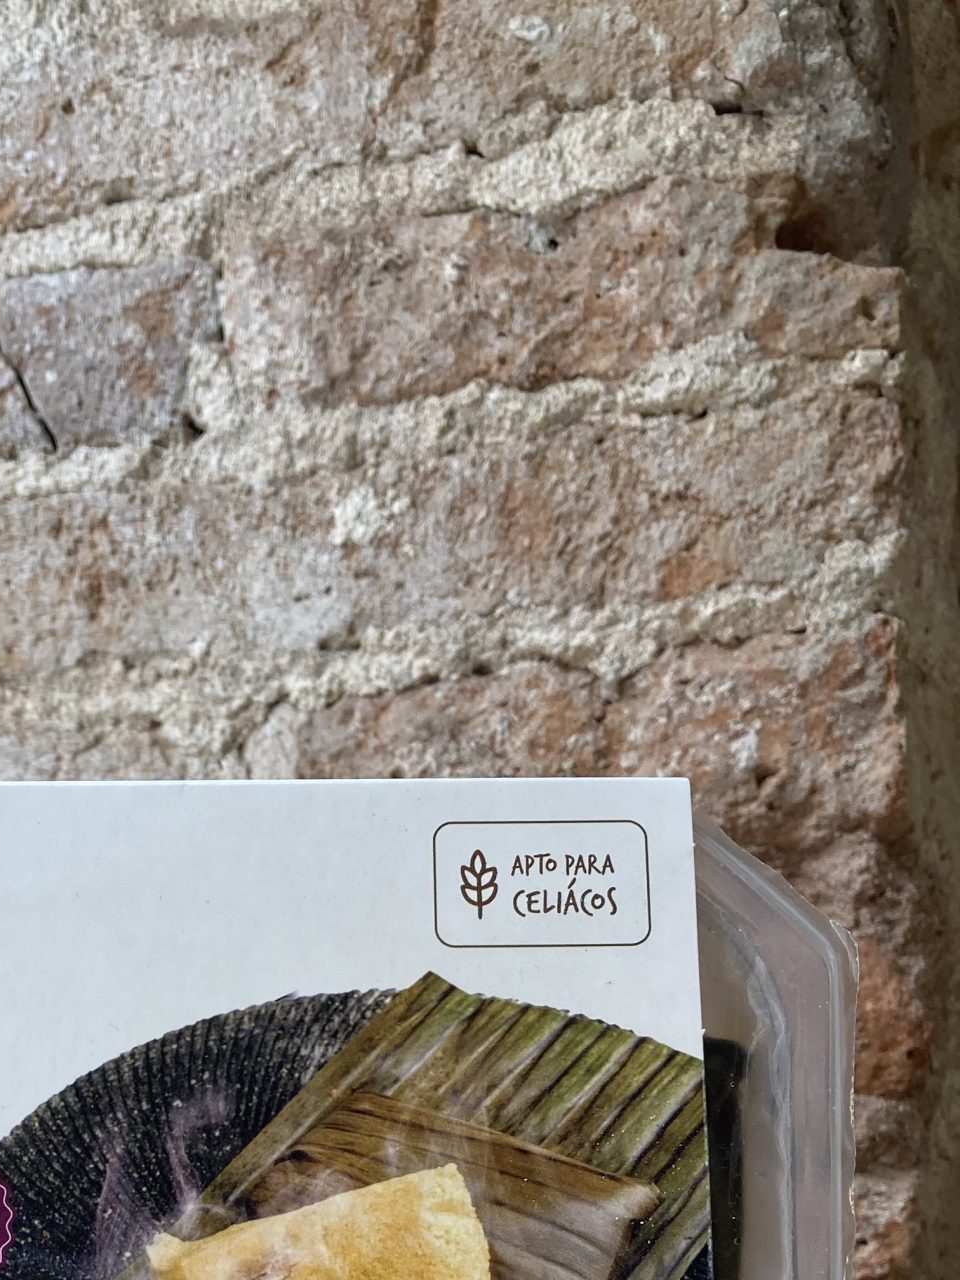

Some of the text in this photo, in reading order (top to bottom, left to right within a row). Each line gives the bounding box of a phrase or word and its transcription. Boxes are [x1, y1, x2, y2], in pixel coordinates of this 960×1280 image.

[511, 853, 615, 876] APTO PARA
[513, 877, 618, 917] CELIÁCOS
